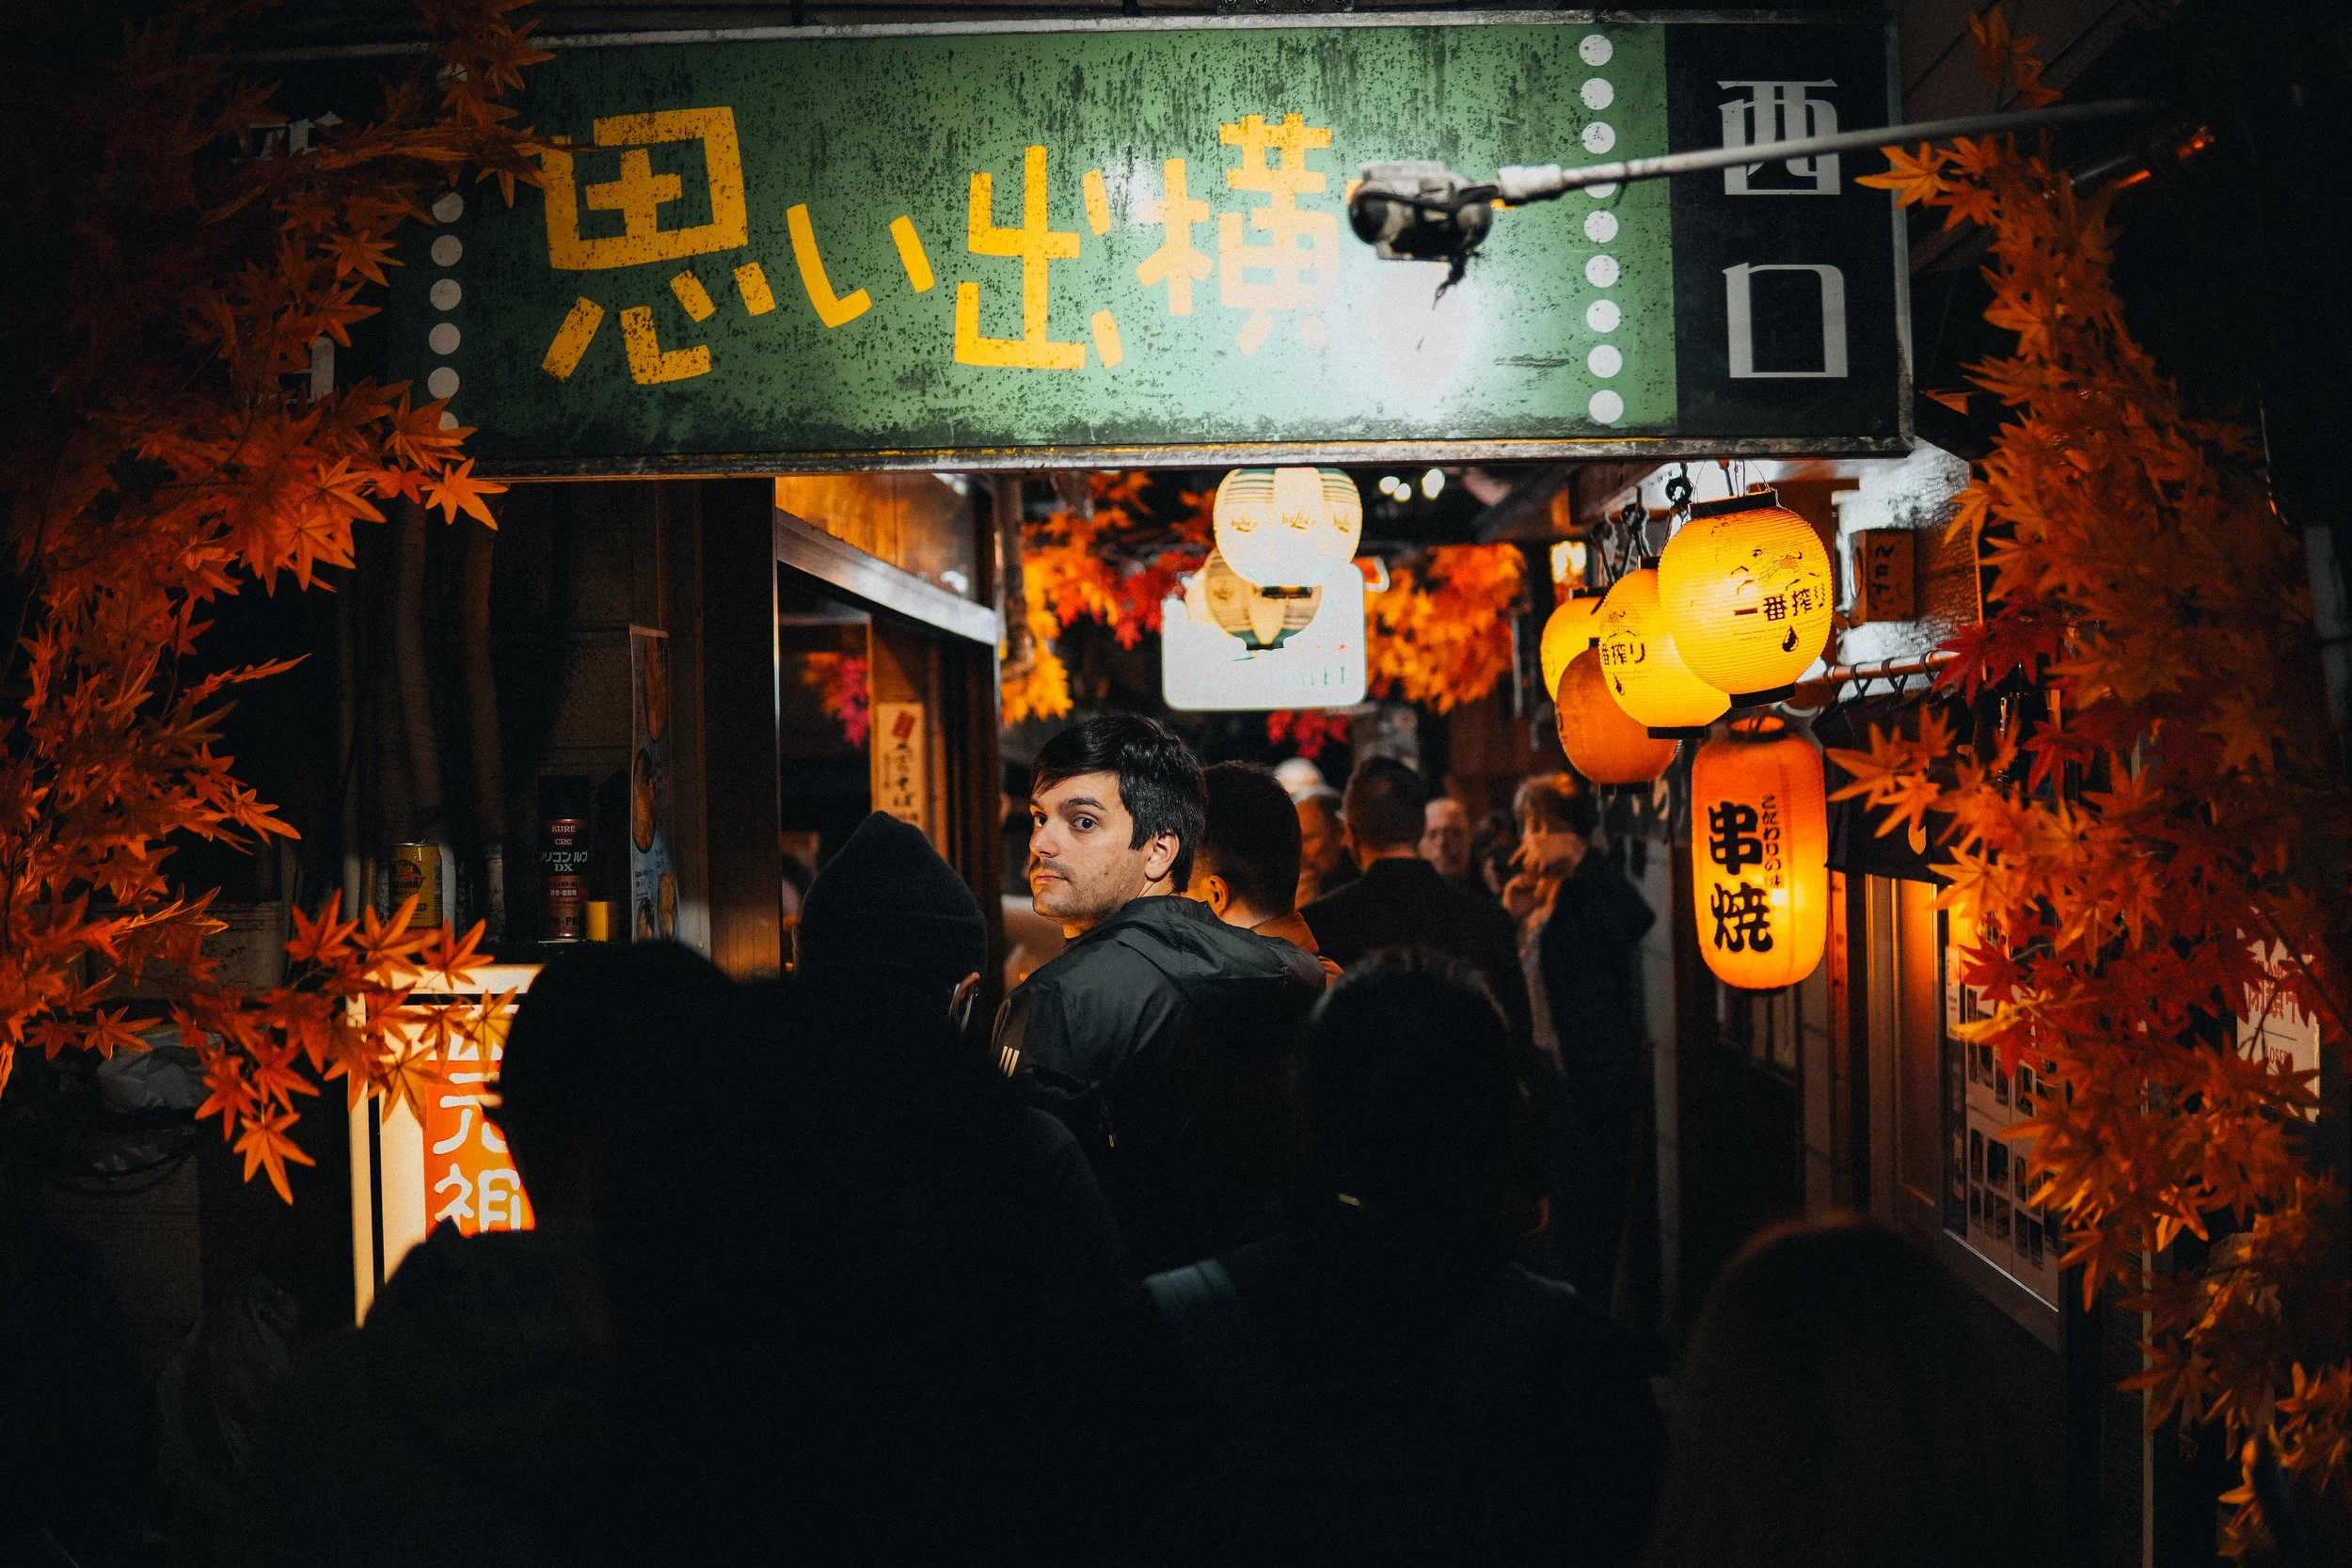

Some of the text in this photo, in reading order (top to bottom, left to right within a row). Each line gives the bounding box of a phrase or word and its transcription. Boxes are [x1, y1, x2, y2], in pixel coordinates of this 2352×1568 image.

[1716, 77, 1848, 378] 西口
[1734, 583, 1826, 621] 一番搾り
[554, 863, 574, 873] DX
[1708, 801, 1774, 953] 串焼
[433, 1071, 520, 1234] 元祖
